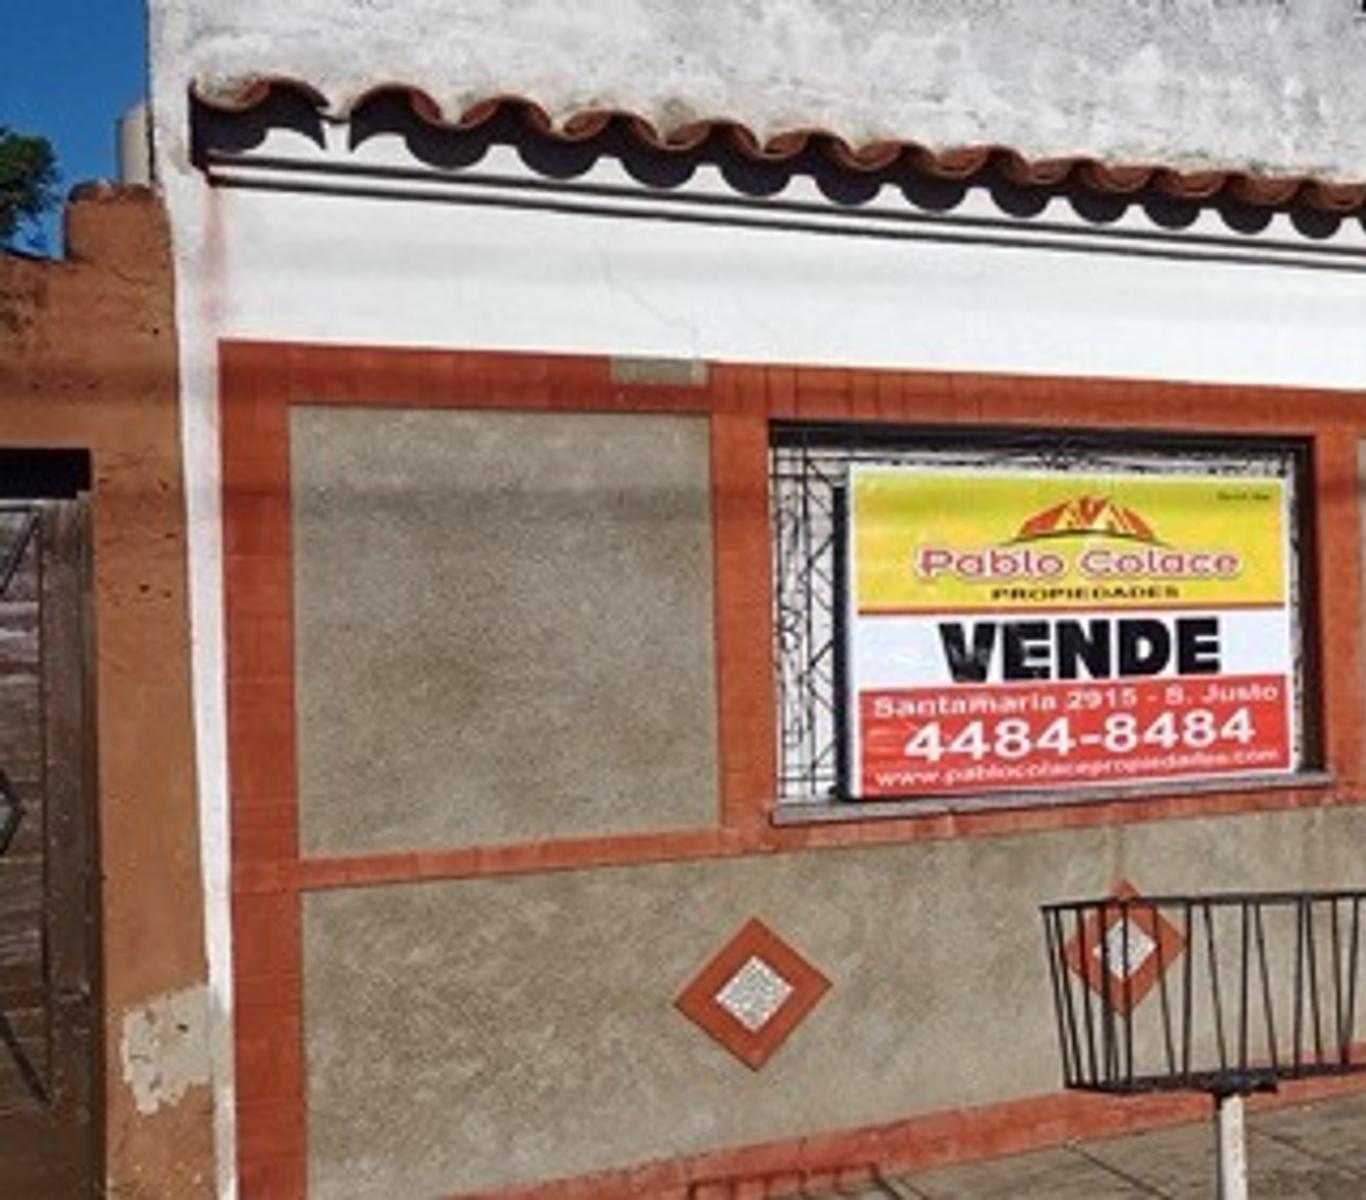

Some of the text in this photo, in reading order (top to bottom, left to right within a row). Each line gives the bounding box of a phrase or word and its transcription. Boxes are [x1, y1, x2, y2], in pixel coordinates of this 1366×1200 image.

[919, 547, 1240, 578] Pablo Colace
[991, 585, 1180, 601] PROPIEDADES
[938, 617, 1221, 684] VENDE
[1066, 687, 1137, 710] 2915
[1202, 682, 1278, 704] Justo
[904, 707, 1256, 763] 4484-8484
